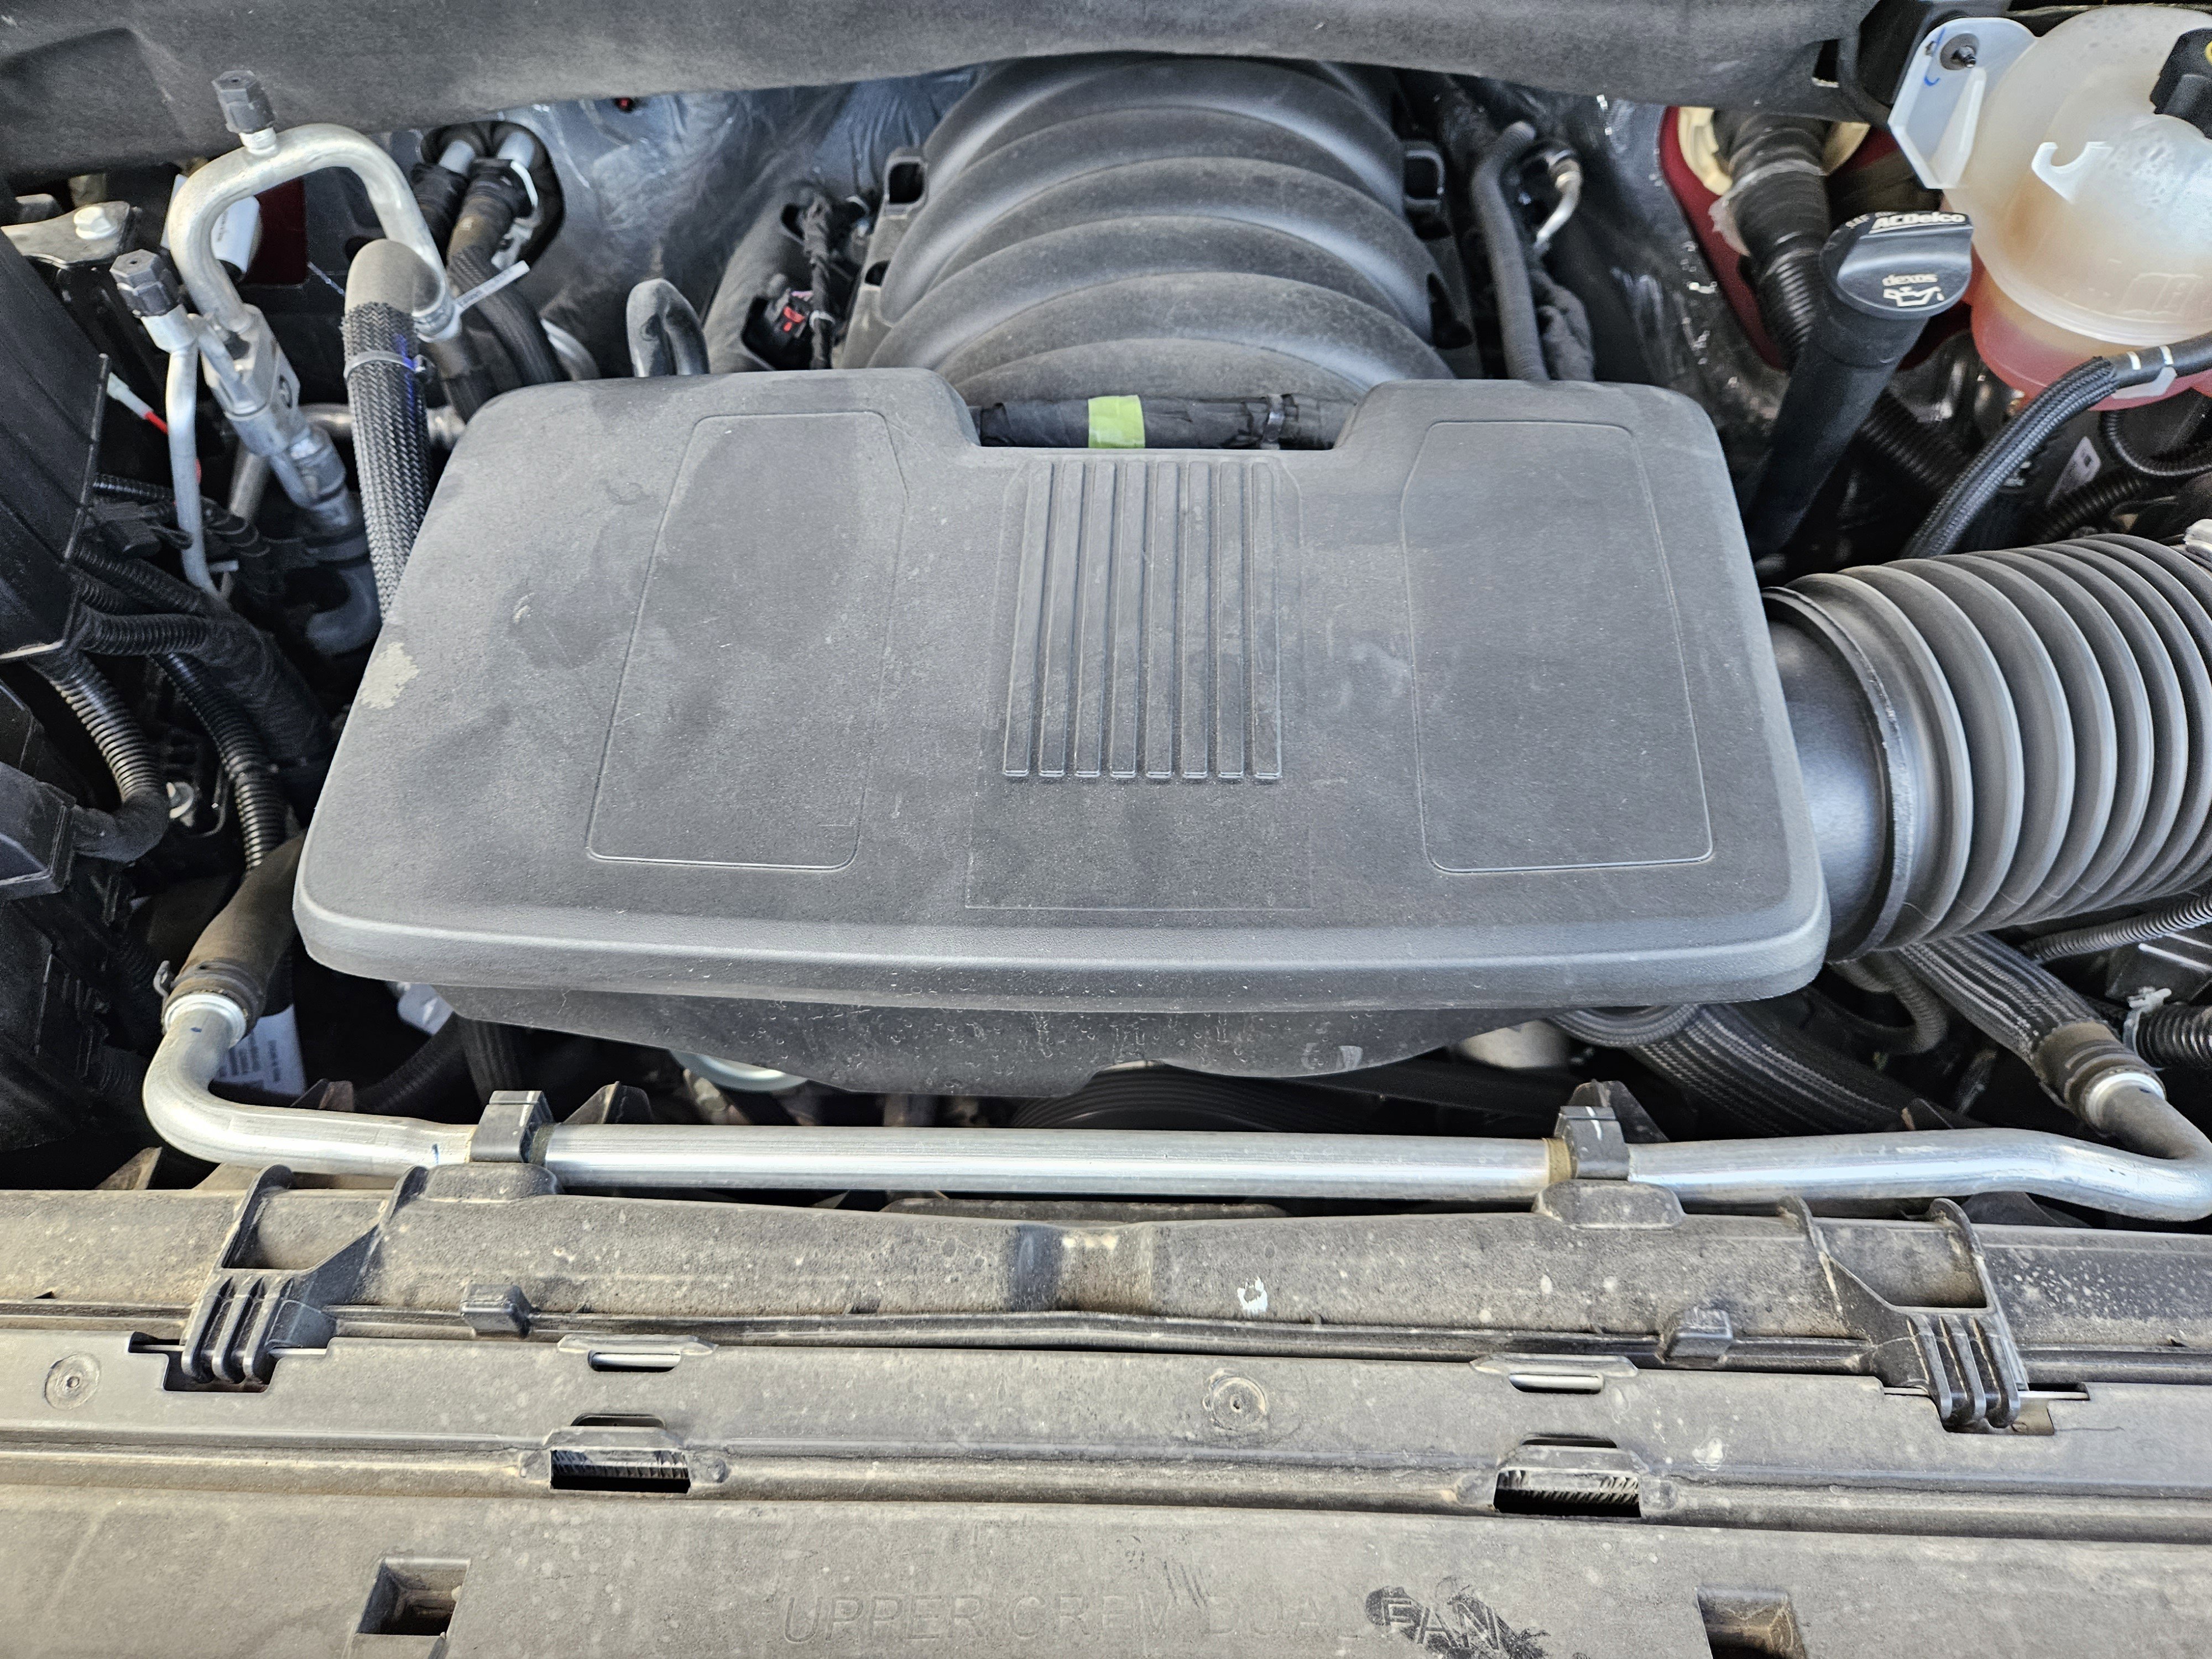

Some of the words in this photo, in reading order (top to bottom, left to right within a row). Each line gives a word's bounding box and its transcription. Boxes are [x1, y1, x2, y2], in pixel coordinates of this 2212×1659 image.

[1871, 212, 1966, 229] ACDelco
[1882, 273, 1938, 286] dexos
[784, 1594, 987, 1642] UPPER
[1383, 1598, 1499, 1650] FAN
